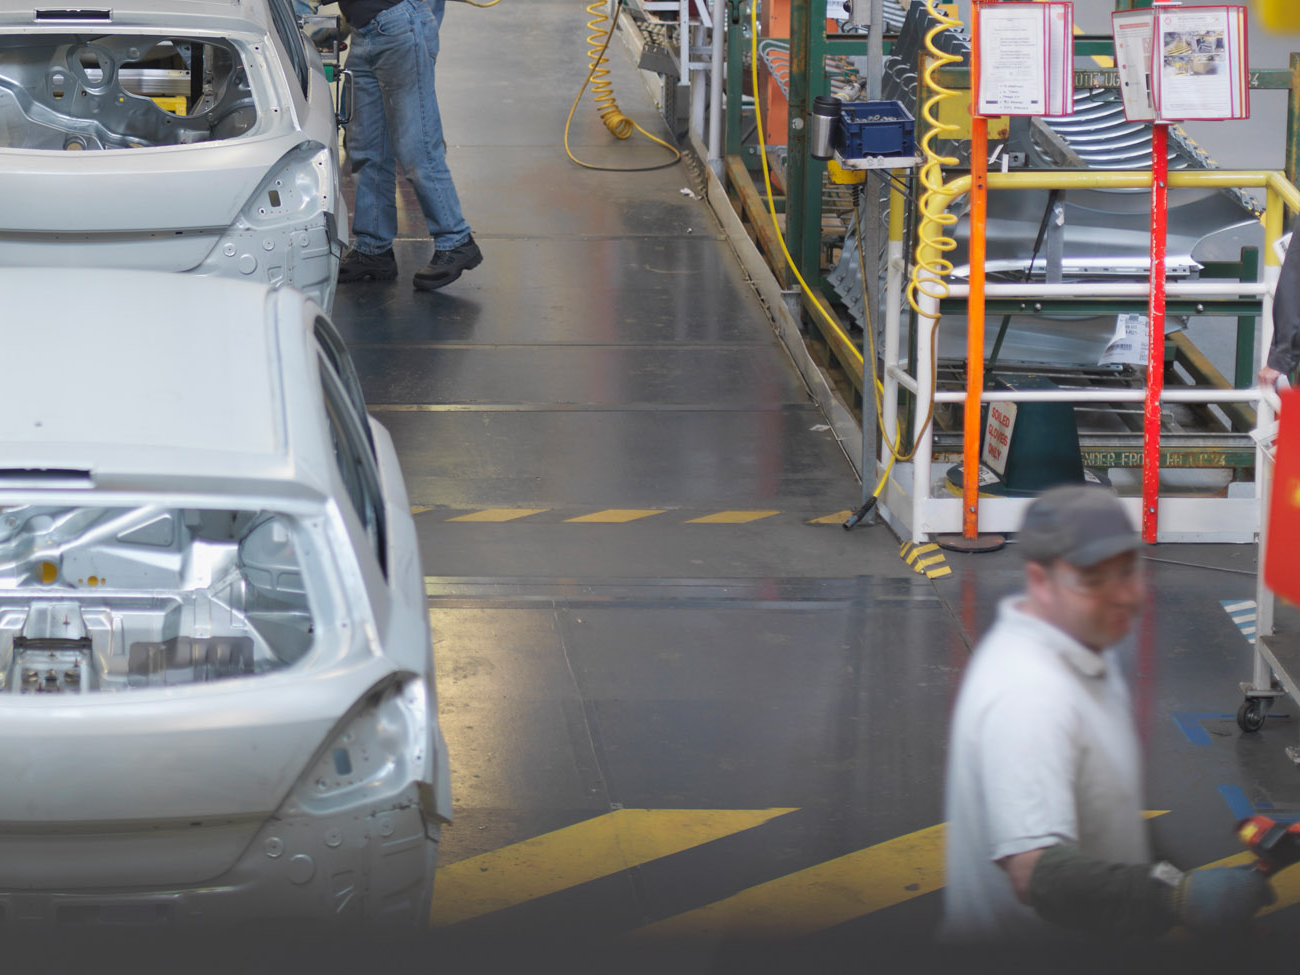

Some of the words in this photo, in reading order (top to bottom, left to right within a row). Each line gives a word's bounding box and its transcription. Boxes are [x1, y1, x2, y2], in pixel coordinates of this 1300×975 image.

[991, 407, 1011, 428] SOILED
[988, 423, 1009, 447] GLOVES
[987, 442, 1002, 462] ONLY
